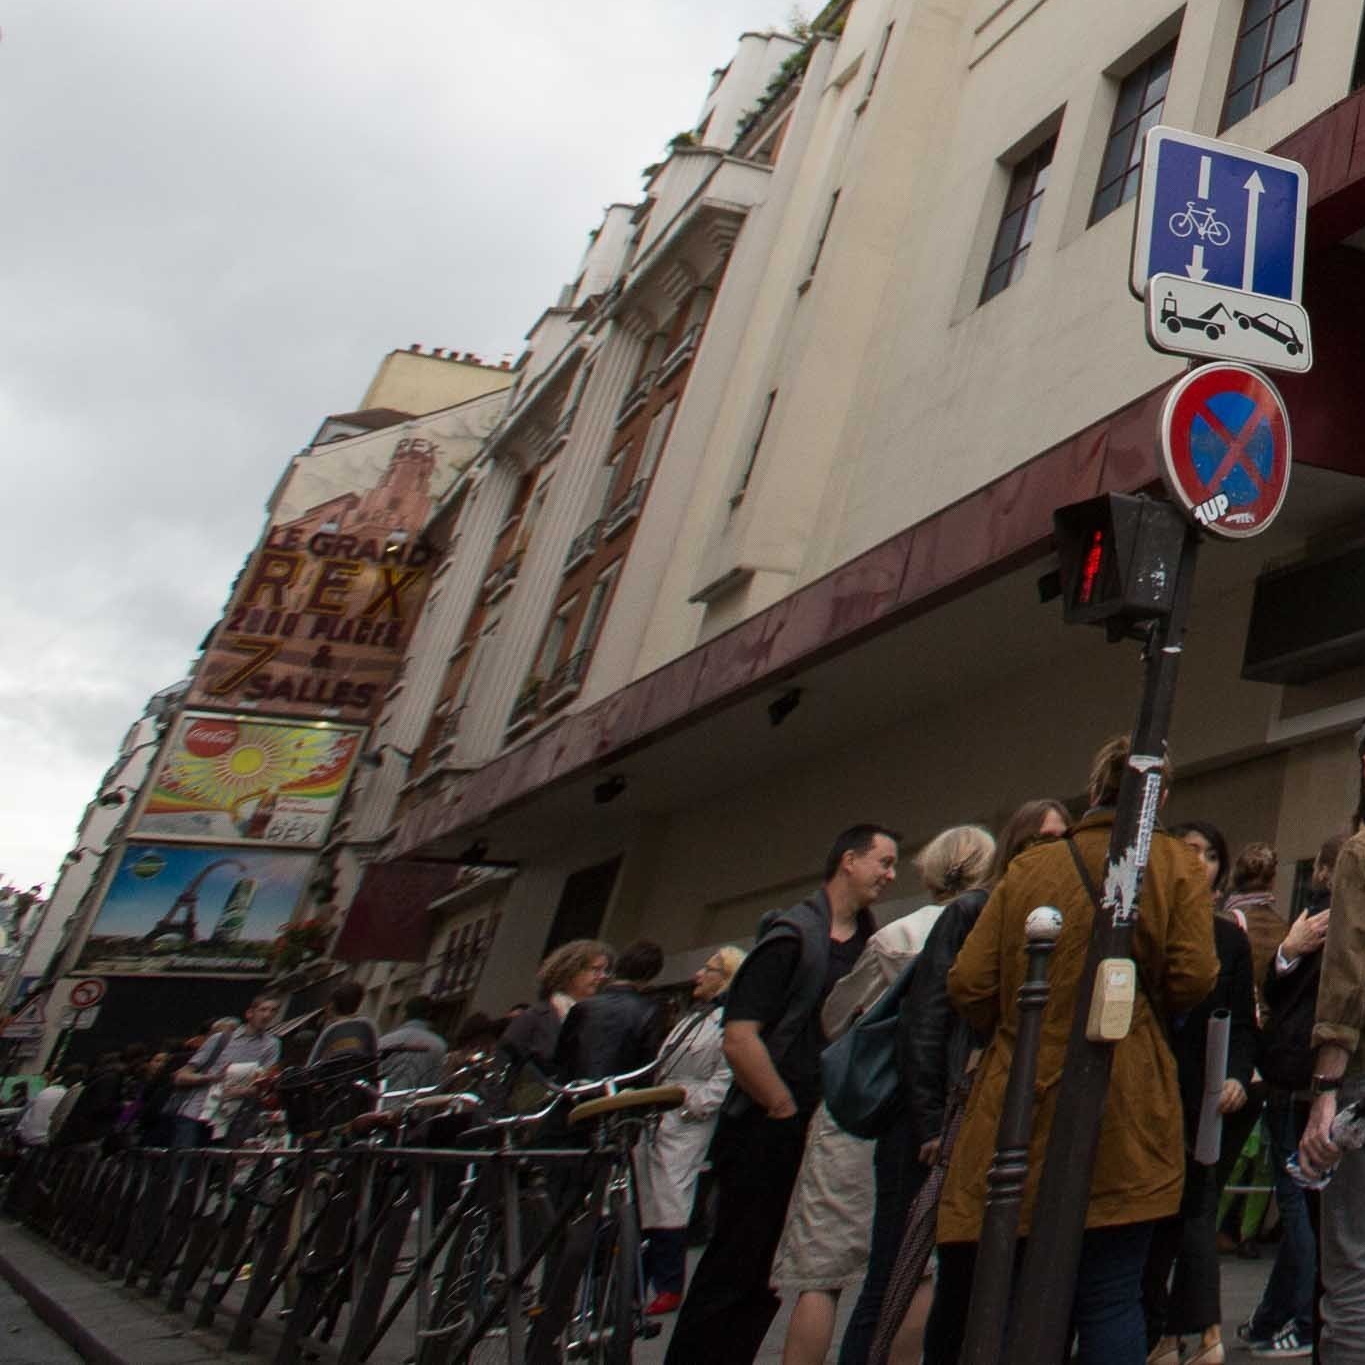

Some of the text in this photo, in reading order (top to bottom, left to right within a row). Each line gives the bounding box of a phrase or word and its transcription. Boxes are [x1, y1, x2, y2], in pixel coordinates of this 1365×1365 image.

[399, 438, 439, 456] REX
[1194, 493, 1229, 526] 1UP
[266, 525, 434, 566] LE GRAND
[243, 550, 425, 619] REX
[205, 636, 373, 706] 7 SALLES
